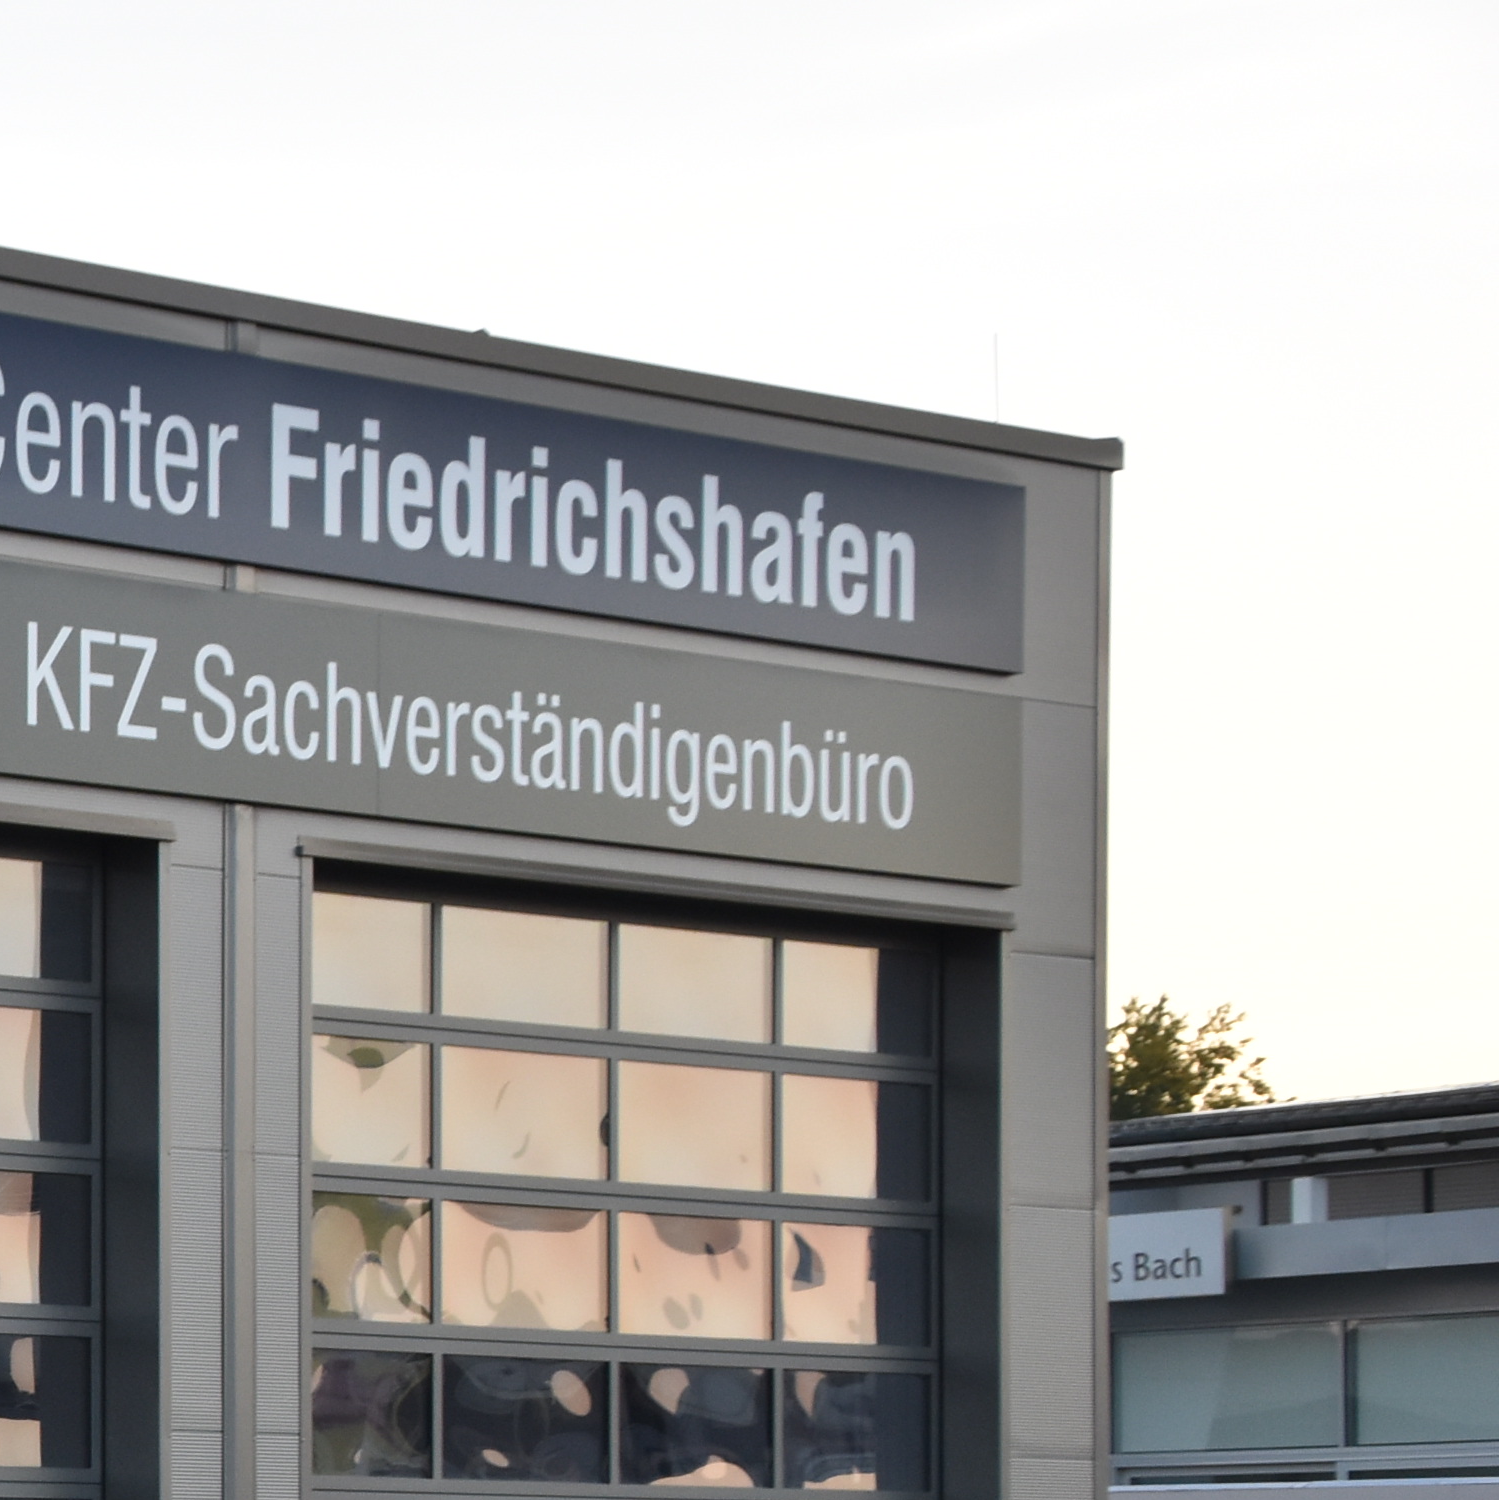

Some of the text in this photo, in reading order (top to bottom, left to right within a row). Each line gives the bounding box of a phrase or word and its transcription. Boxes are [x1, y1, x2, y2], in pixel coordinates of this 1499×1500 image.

[271, 402, 916, 622] Friedrichshafen
[26, 620, 915, 830] KFZ-Sachverständigenbüro
[1134, 1247, 1201, 1281] Bach
